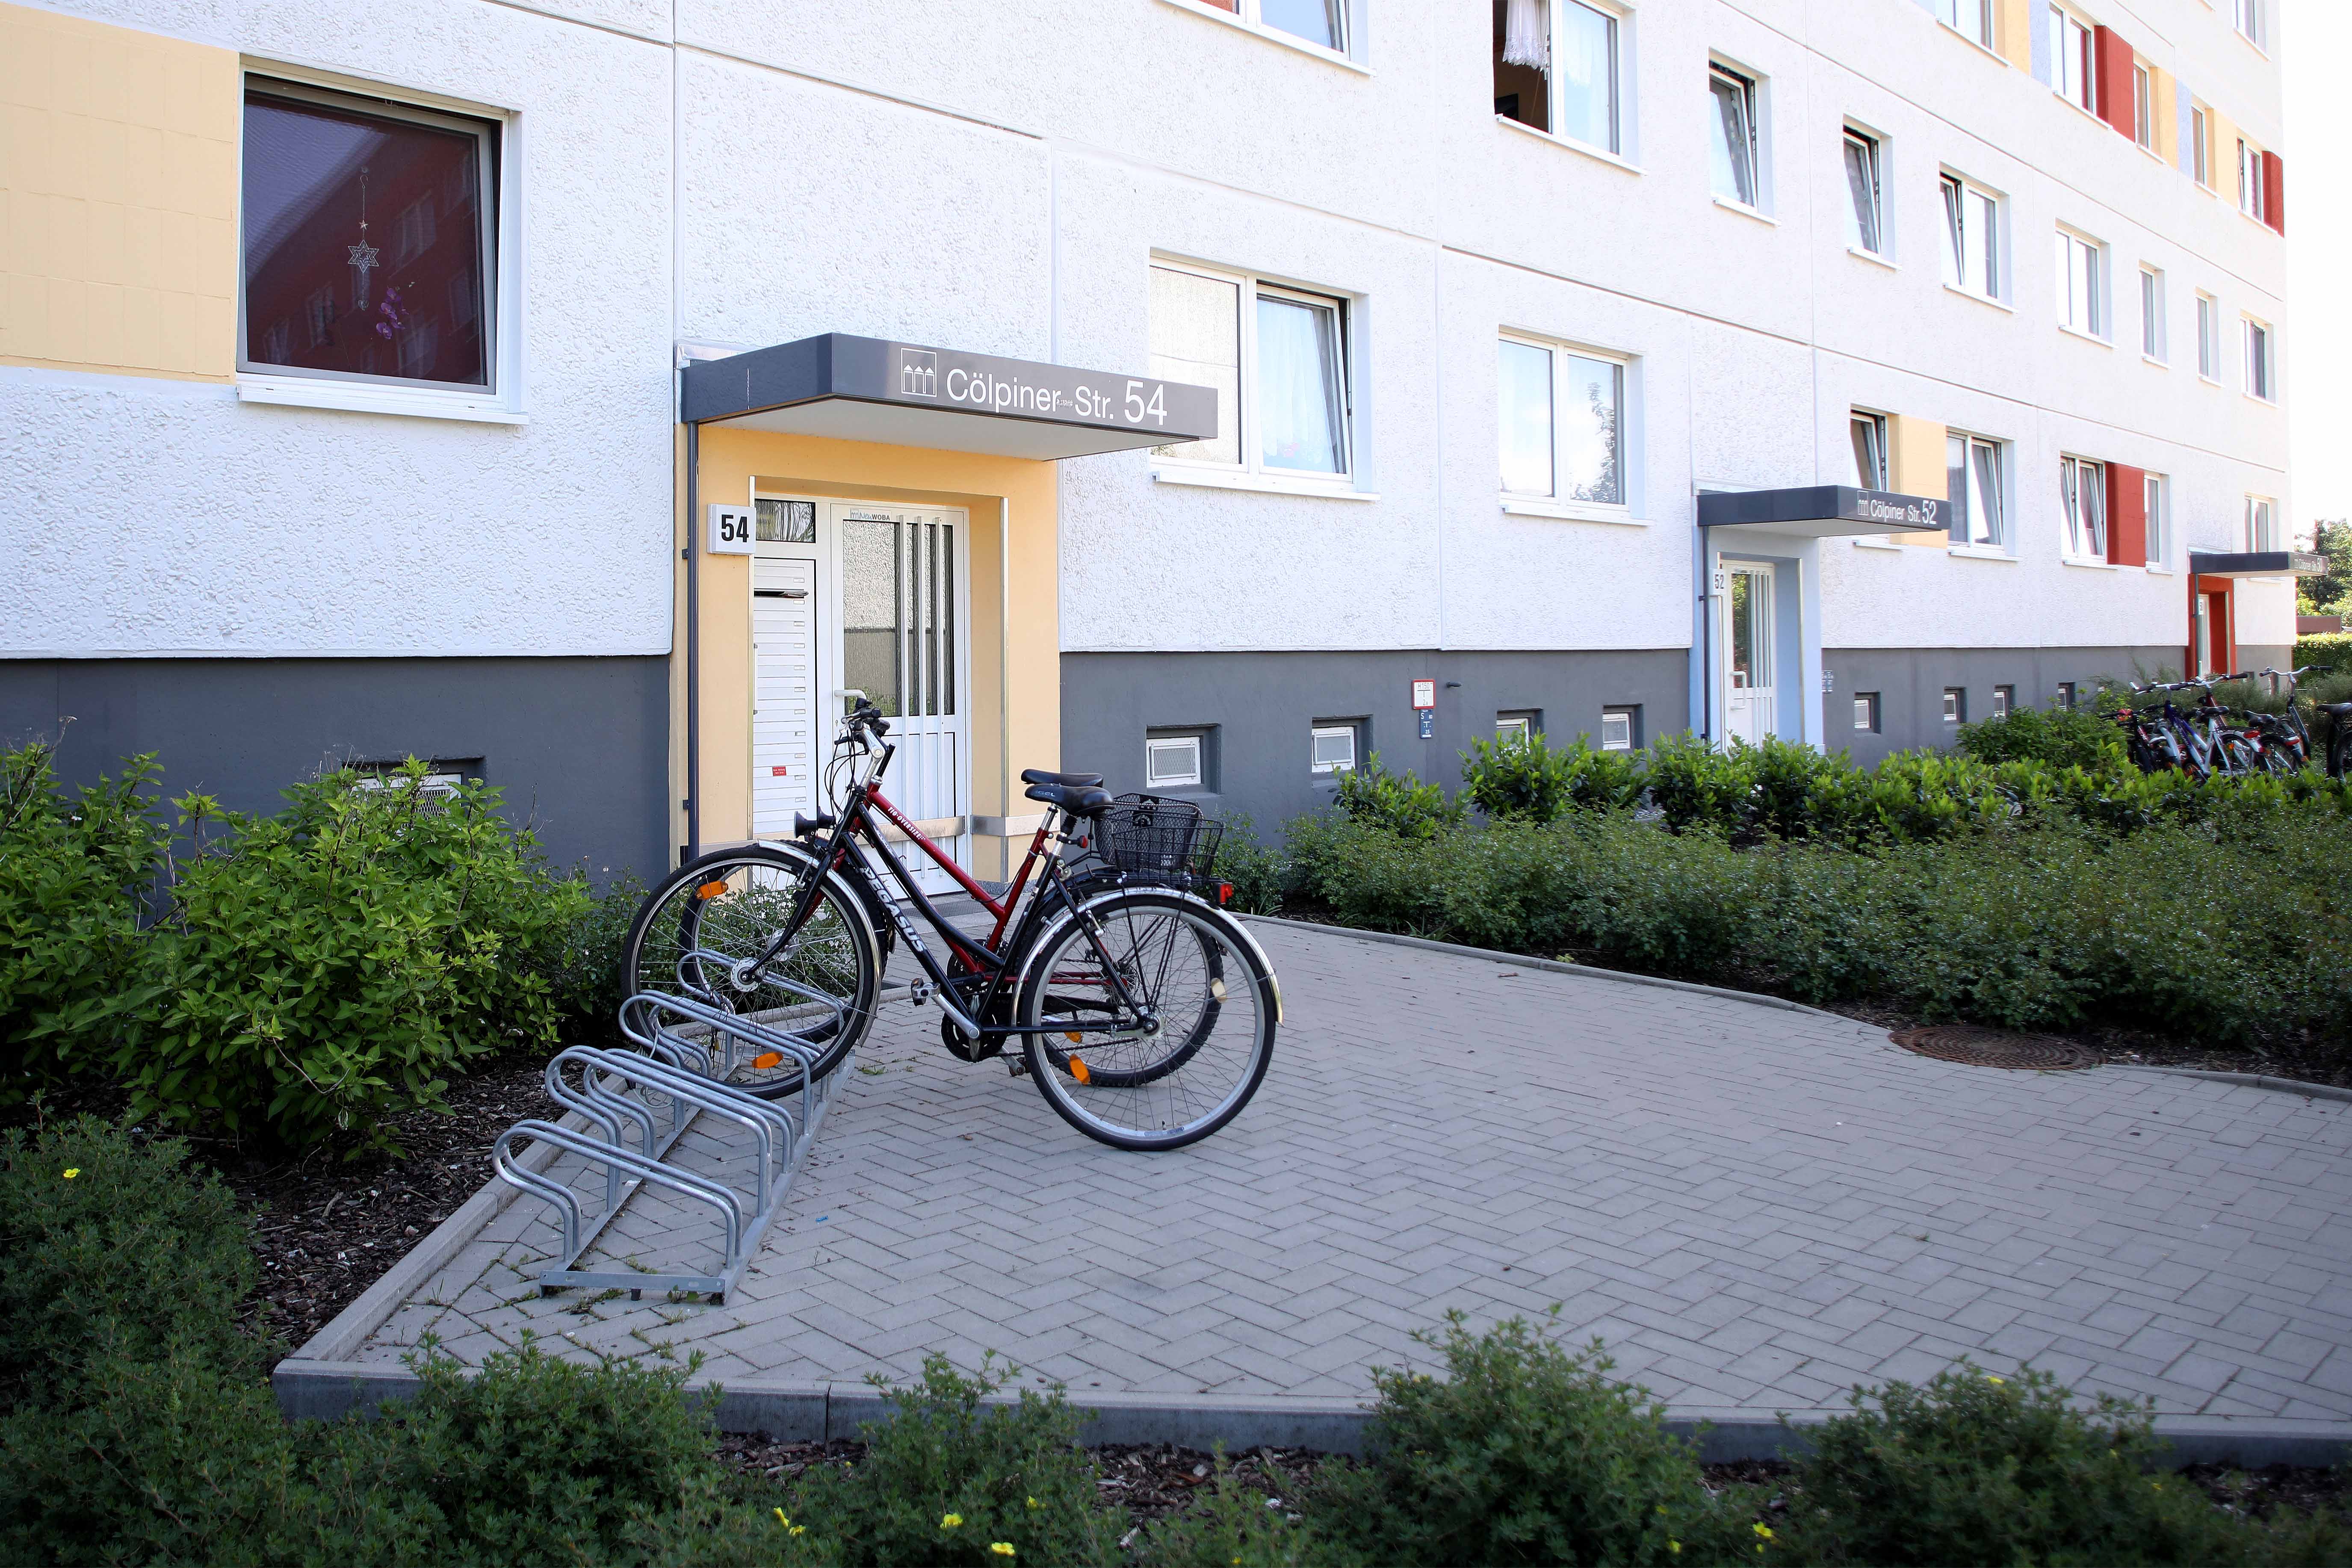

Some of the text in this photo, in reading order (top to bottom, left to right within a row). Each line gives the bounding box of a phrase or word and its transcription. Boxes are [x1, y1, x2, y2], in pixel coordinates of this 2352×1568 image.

[947, 369, 1167, 425] Cölpiner Str. 54
[1870, 499, 1936, 525] Cölpiner Str. 52
[721, 514, 749, 542] 54
[1715, 574, 1724, 589] 52
[860, 867, 927, 952] PEGASUS
